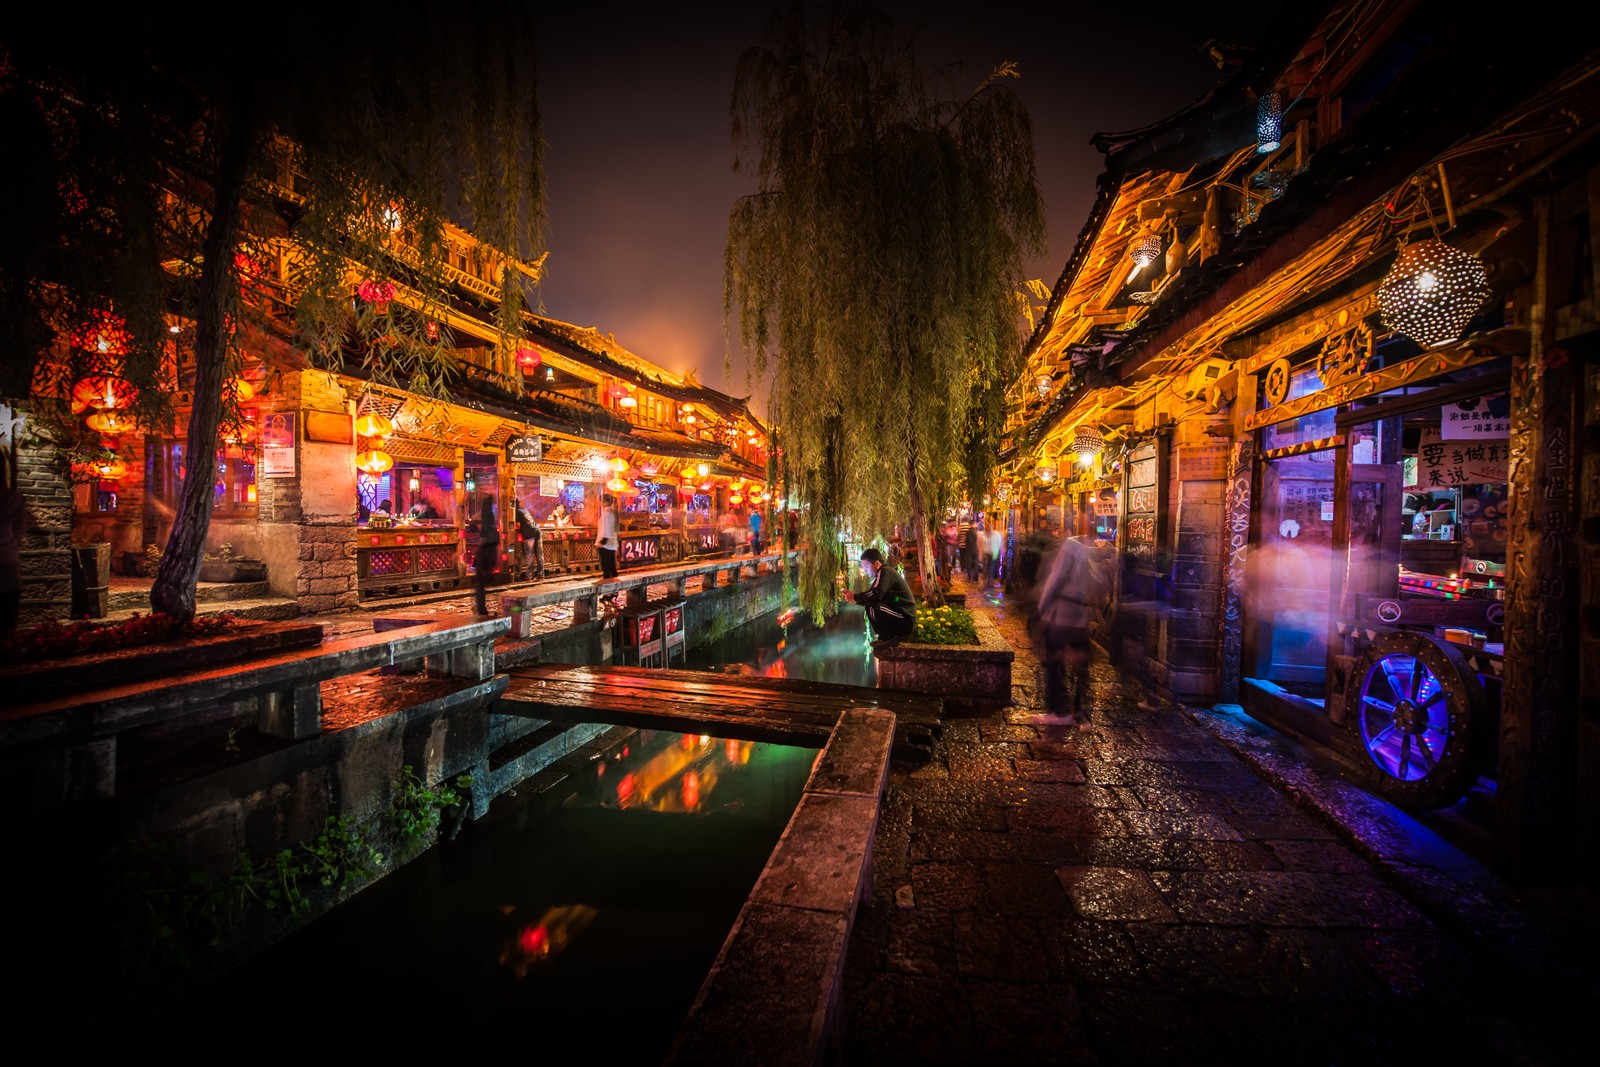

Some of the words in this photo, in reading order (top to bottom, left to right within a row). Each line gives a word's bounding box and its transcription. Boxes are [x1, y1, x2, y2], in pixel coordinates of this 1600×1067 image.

[1429, 466, 1468, 486] 来说
[625, 540, 655, 559] 2416
[702, 534, 719, 549] 2416
